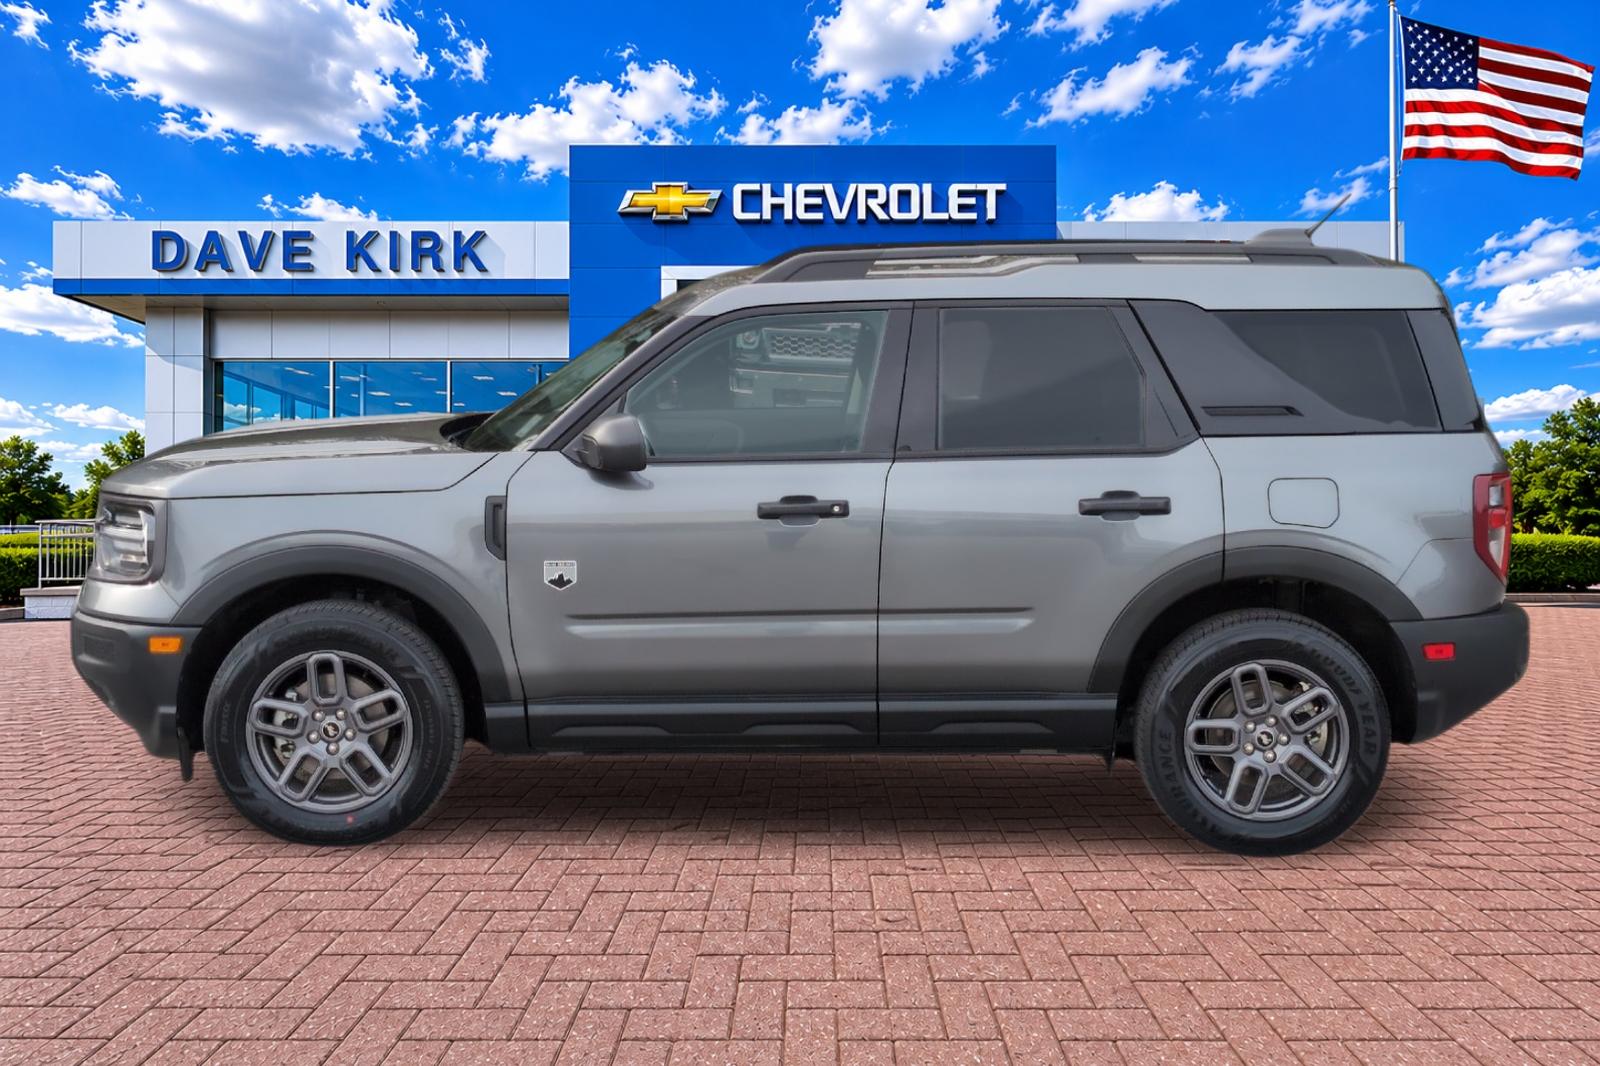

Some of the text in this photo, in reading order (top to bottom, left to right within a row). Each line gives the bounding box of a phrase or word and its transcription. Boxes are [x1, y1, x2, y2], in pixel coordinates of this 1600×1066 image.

[732, 182, 1007, 223] CHEVROLET
[151, 230, 489, 273] DAVE KIRK
